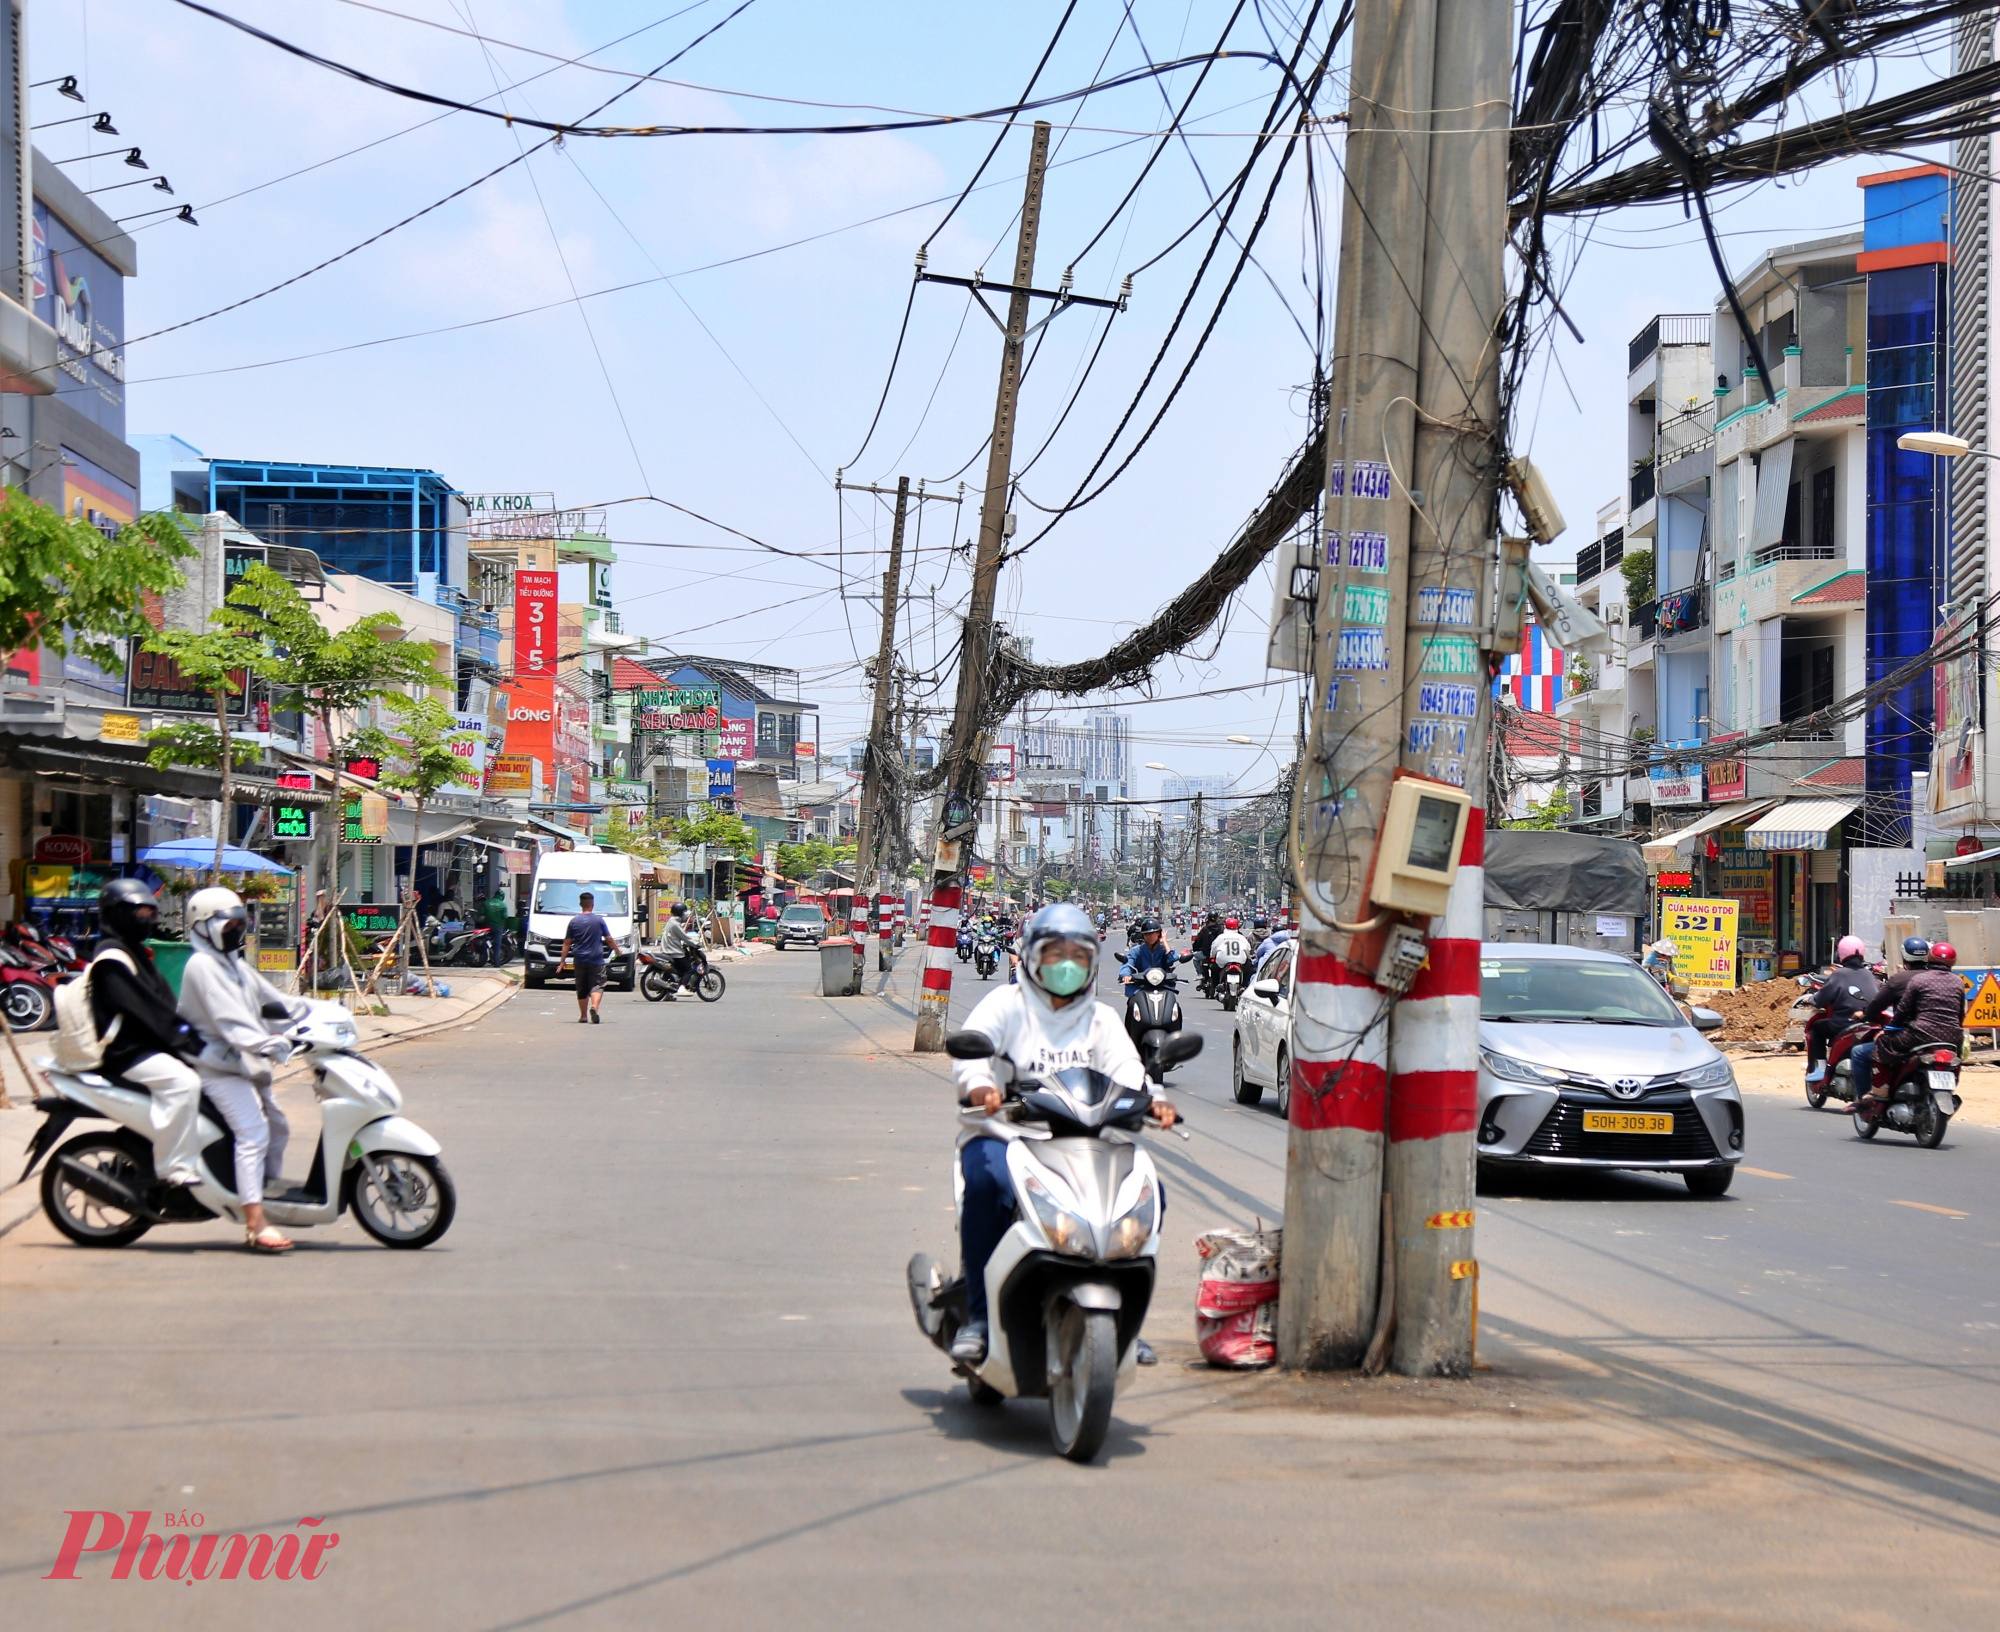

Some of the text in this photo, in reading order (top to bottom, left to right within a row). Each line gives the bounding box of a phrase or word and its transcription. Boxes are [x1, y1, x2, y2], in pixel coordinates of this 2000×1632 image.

[493, 496, 532, 510] KHOA
[534, 576, 551, 586] MẠCH
[533, 588, 554, 598] ĐƯỜNG
[672, 690, 714, 706] KHOA
[672, 712, 716, 729] GIANG
[513, 764, 530, 773] HUY
[45, 842, 81, 852] KOVA
[1749, 852, 1763, 868] CAO
[1668, 902, 1734, 914] CỬA HÀNG ĐTDĐ
[1674, 915, 1723, 932] 521
[1694, 936, 1711, 944] THOẠI
[1714, 934, 1730, 952] LẤY
[1225, 941, 1240, 956] 19
[1710, 954, 1730, 971] LIỀN
[1985, 993, 1996, 1004] ĐI
[1974, 1006, 2000, 1022] CHẬ
[1592, 1114, 1665, 1130] 50H-309.38
